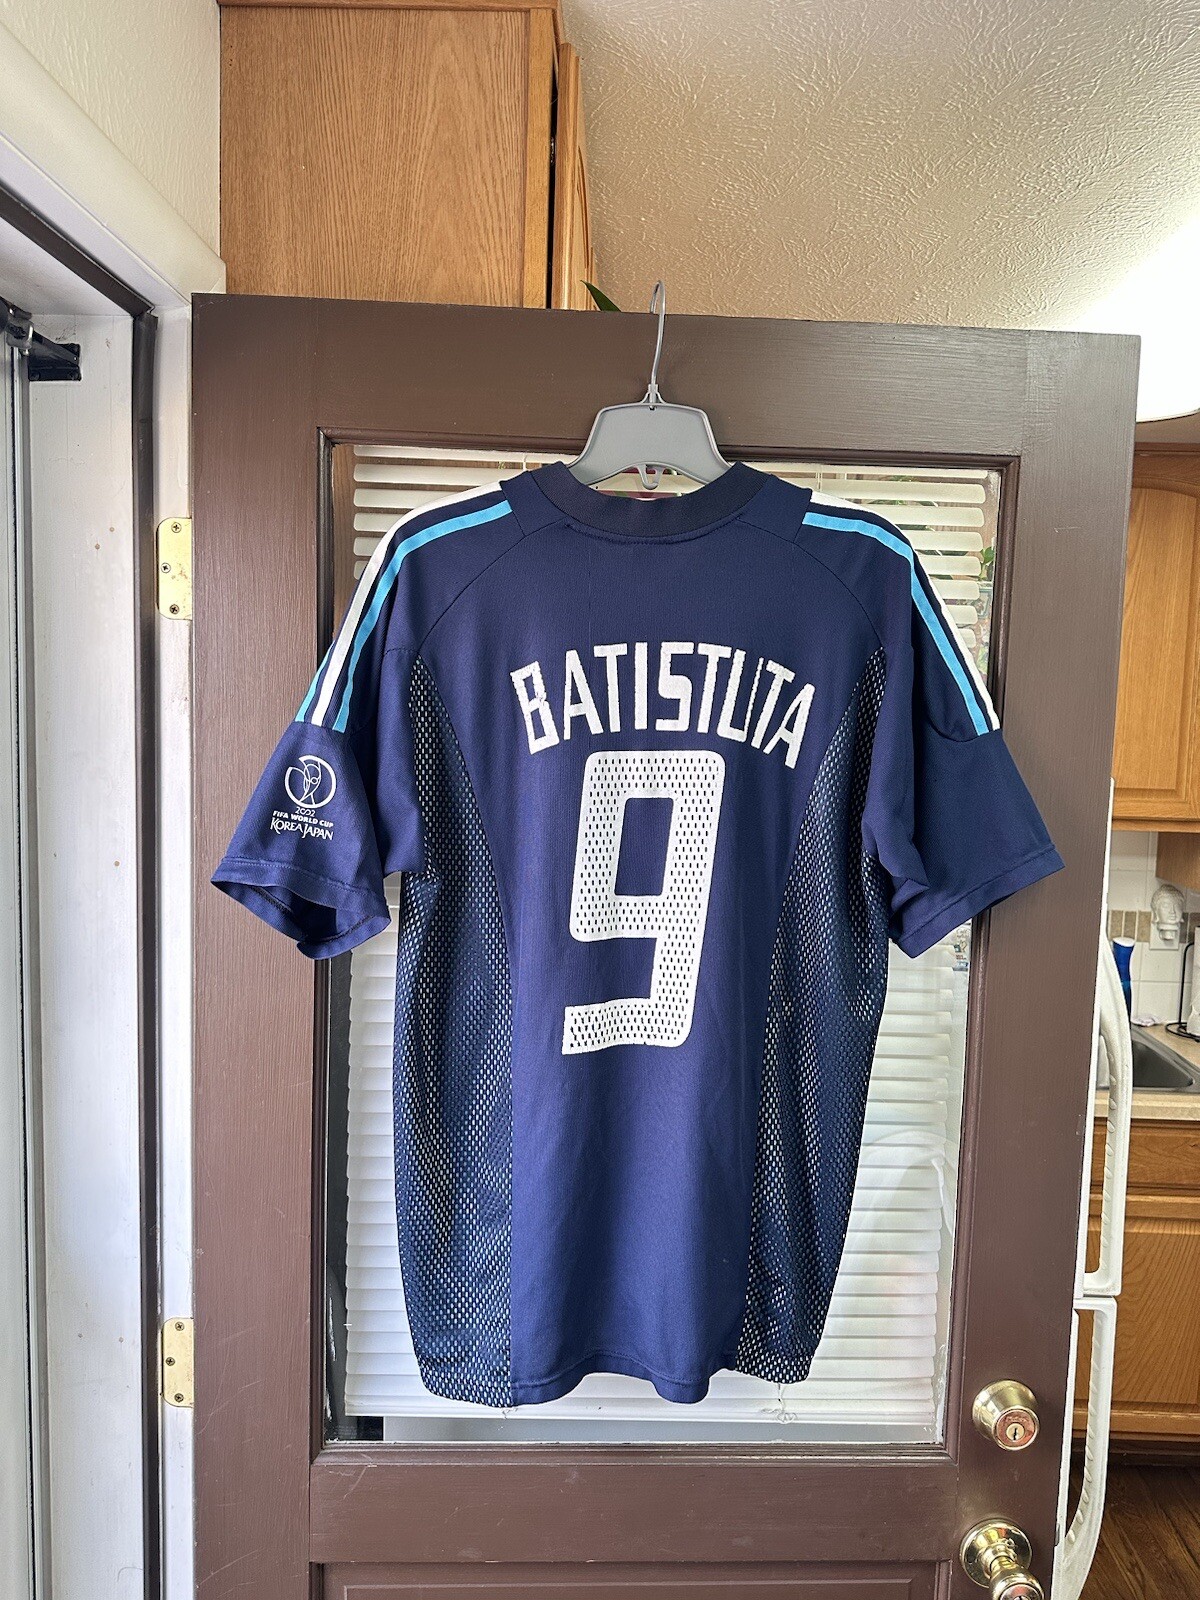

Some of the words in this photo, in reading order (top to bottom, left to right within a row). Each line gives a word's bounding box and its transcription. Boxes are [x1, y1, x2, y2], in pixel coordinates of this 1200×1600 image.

[510, 641, 816, 769] BATISTUTA
[272, 810, 289, 819] FIFA
[290, 813, 318, 825] WORLD
[319, 820, 334, 828] CUP
[294, 806, 316, 817] 2002
[270, 817, 303, 835] KOREA
[302, 823, 334, 840] JAPAN
[562, 750, 726, 1055] 9
